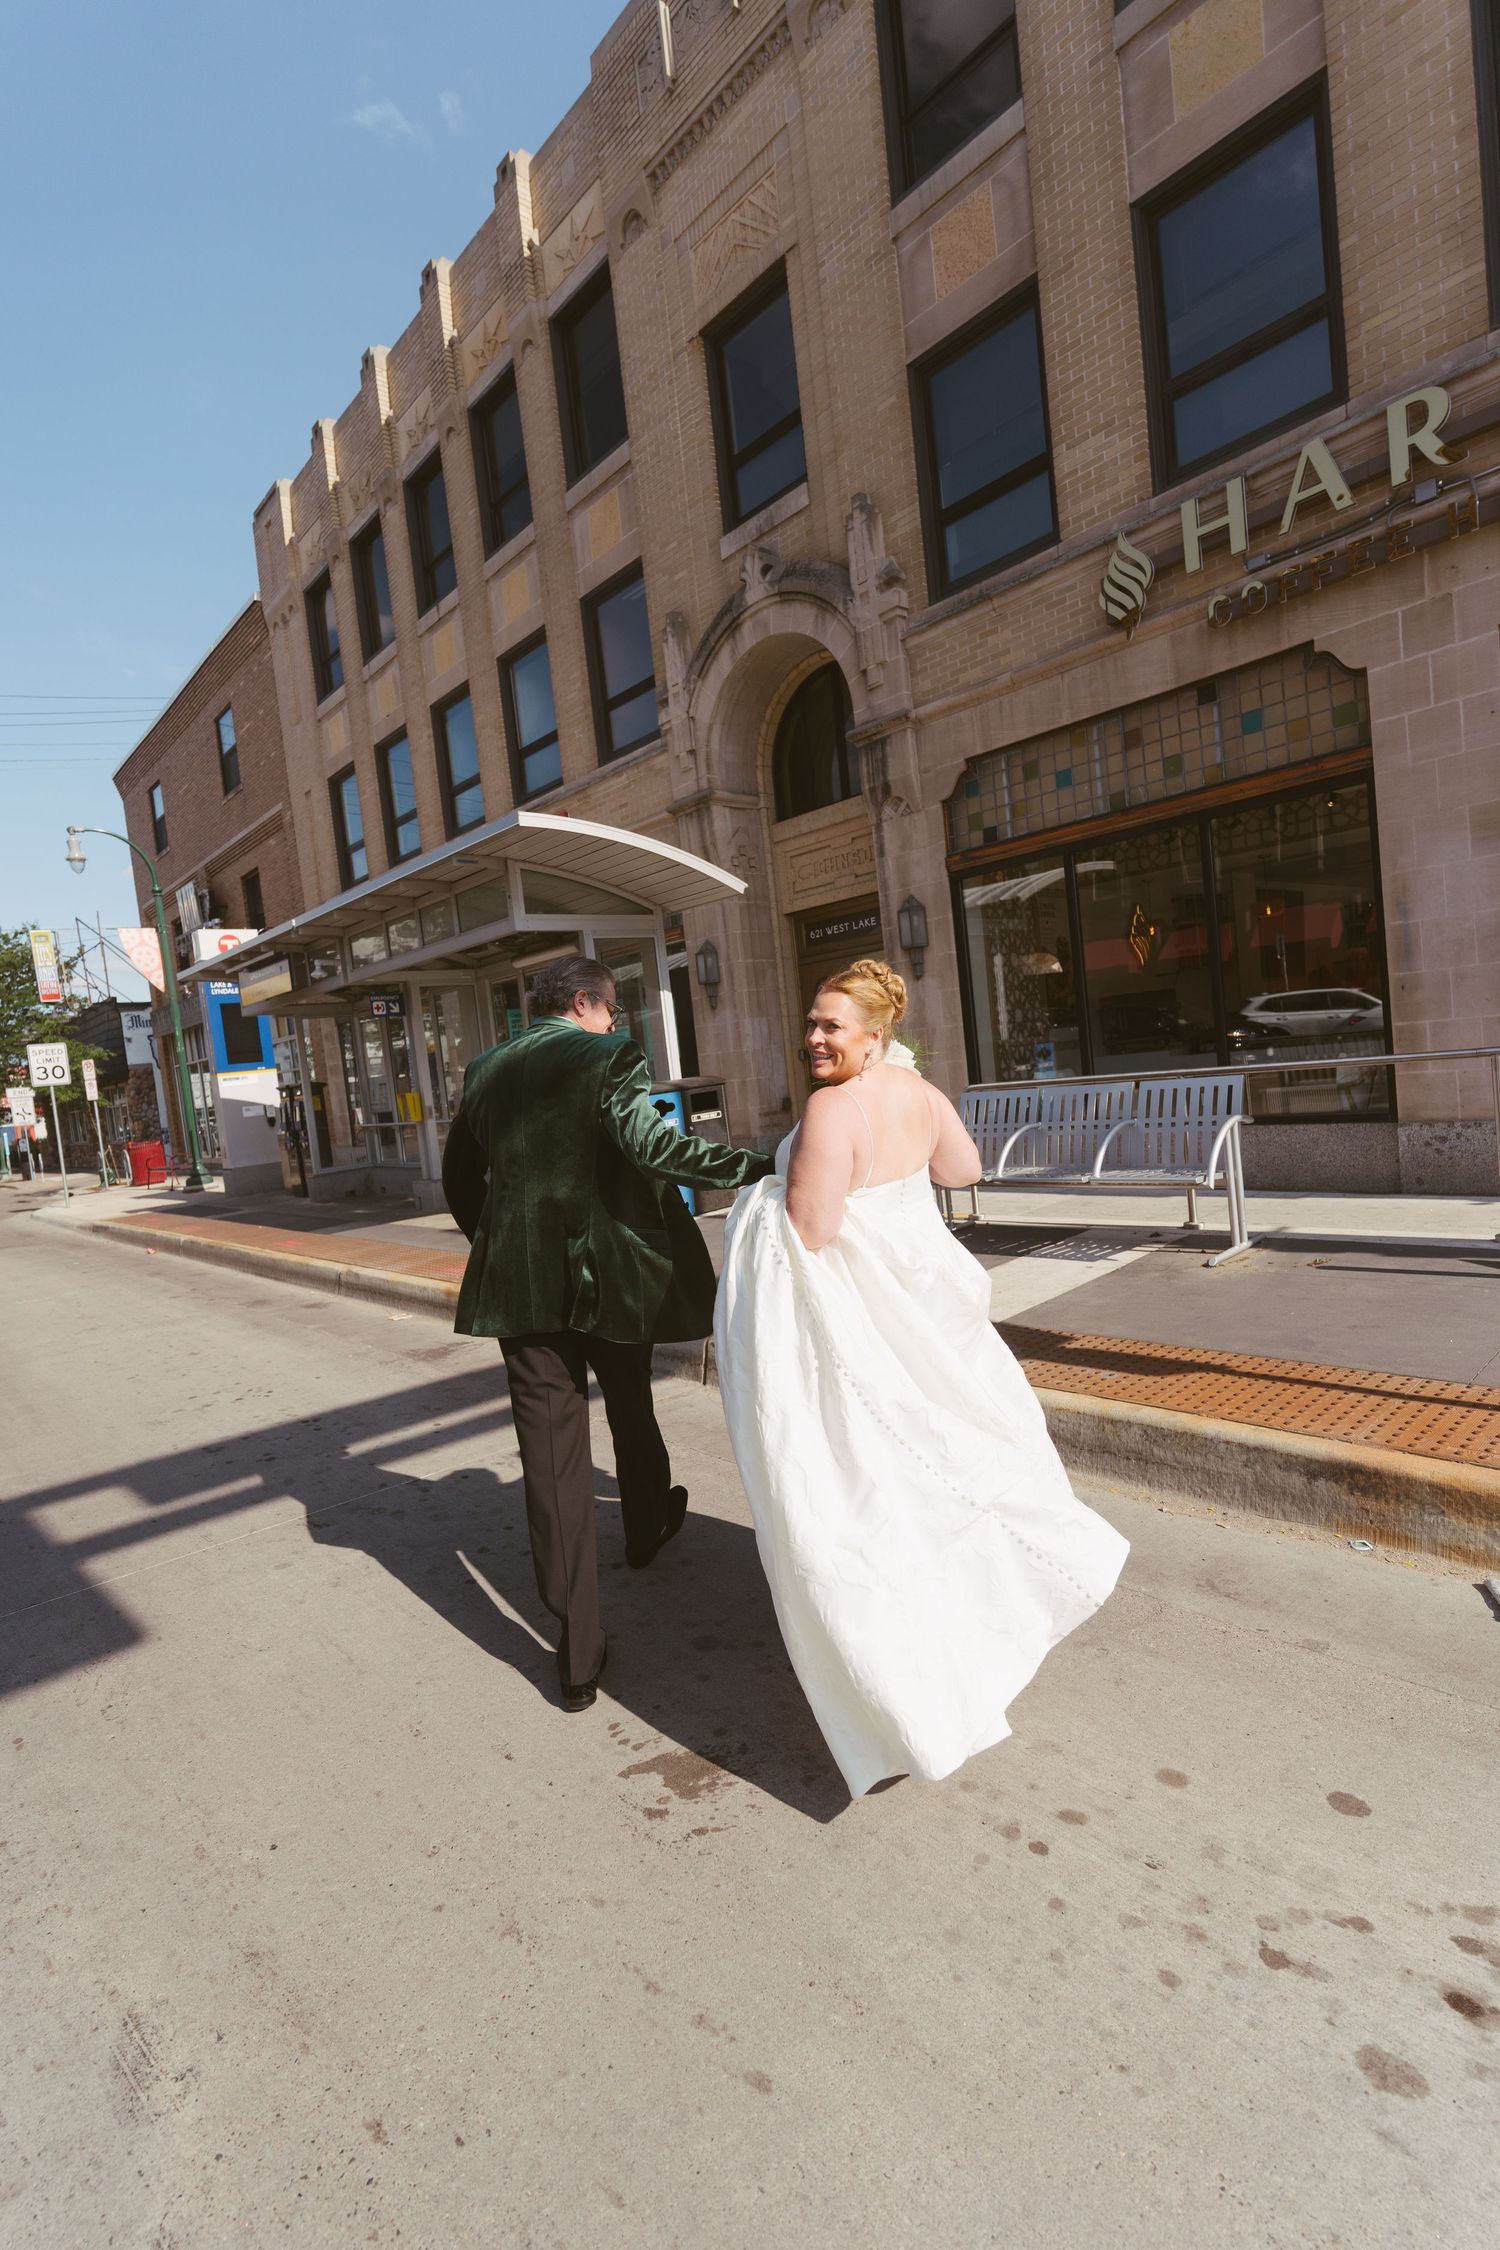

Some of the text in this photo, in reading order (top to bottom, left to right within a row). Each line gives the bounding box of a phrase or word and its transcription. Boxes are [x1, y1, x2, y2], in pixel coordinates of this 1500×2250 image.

[1181, 386, 1470, 576] HAR
[1208, 519, 1416, 628] COFFEE
[810, 916, 877, 940] 621 WEST LAKE
[211, 988, 239, 996] LYNDALE
[32, 1048, 63, 1057] SPEED
[36, 1056, 60, 1065] LIMIT
[36, 1065, 65, 1080] 30
